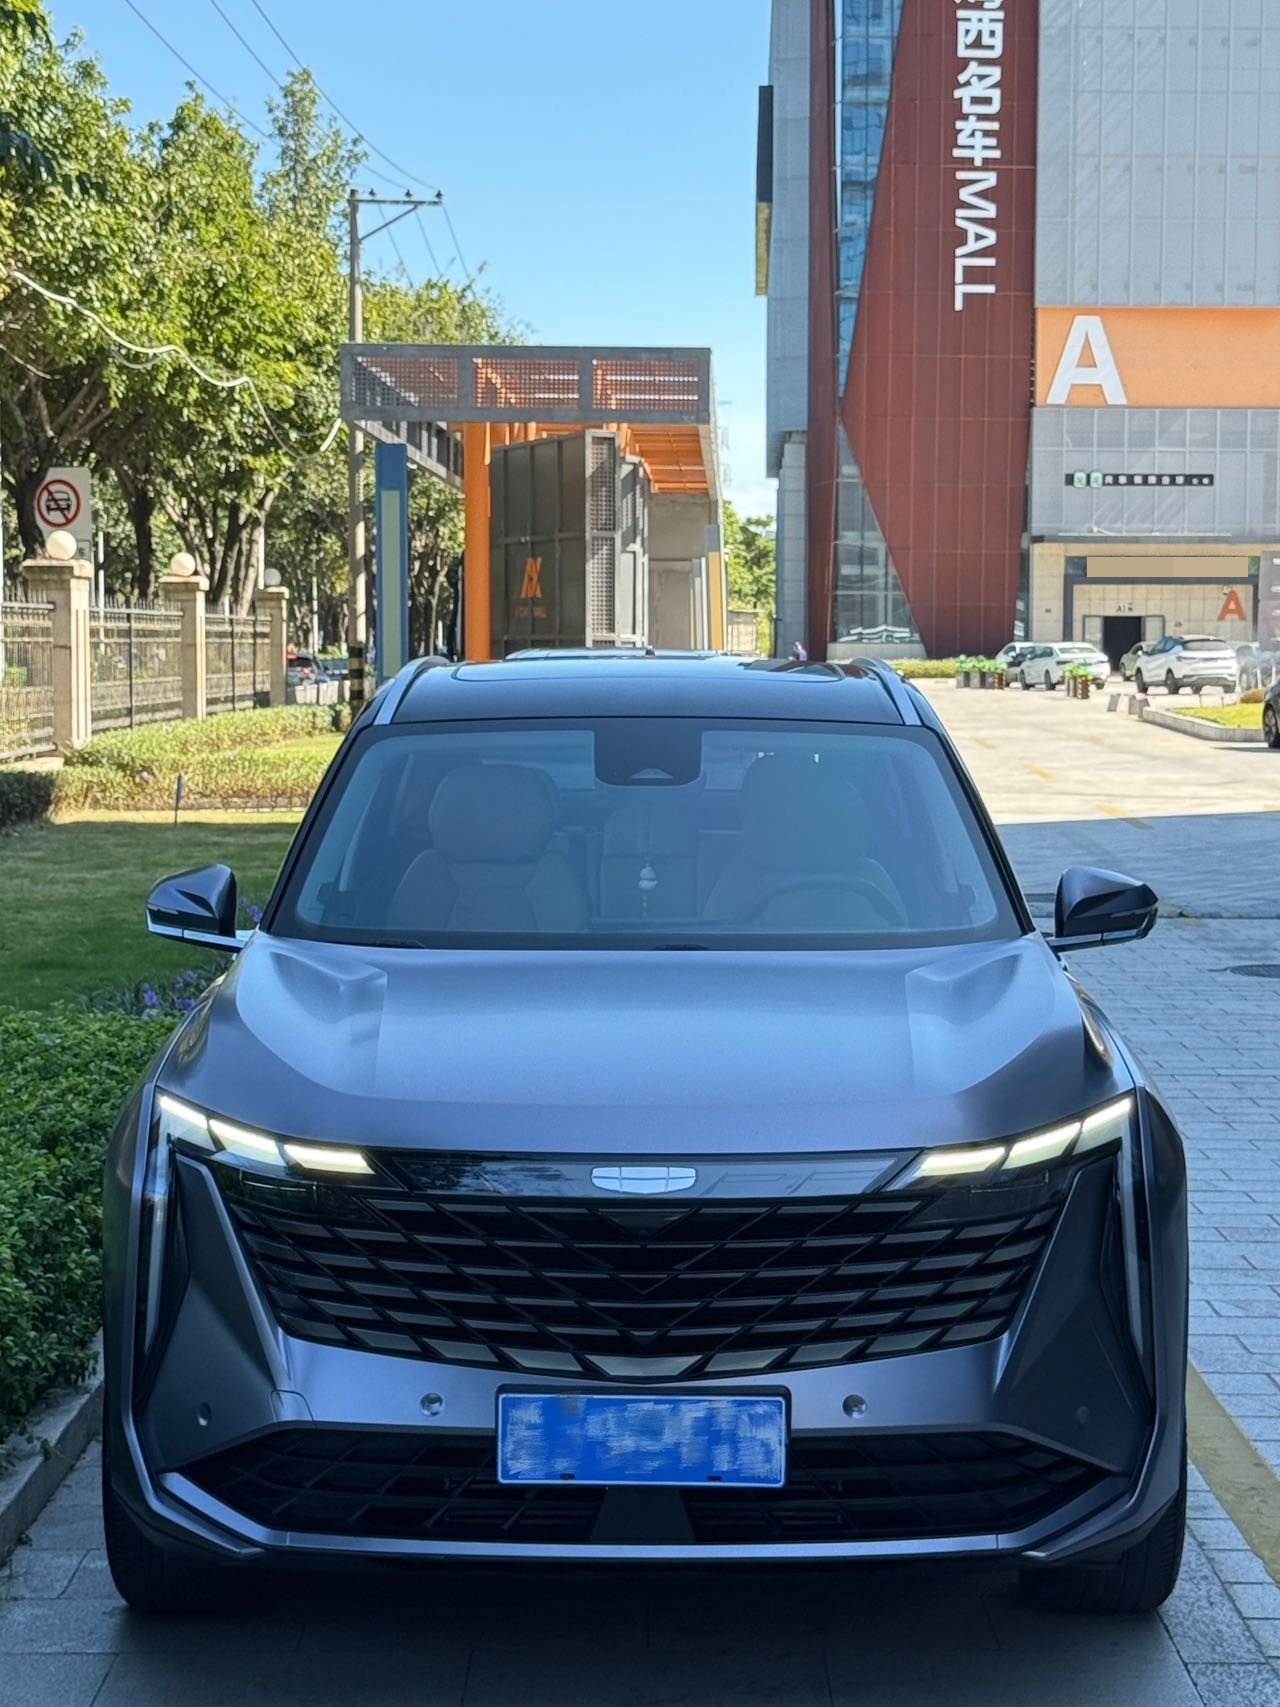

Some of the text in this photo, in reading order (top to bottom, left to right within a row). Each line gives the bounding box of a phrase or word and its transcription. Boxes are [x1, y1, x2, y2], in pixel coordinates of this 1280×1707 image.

[953, 0, 1005, 311] 西名车MALL
[1046, 315, 1128, 405] A
[1217, 590, 1247, 621] A
